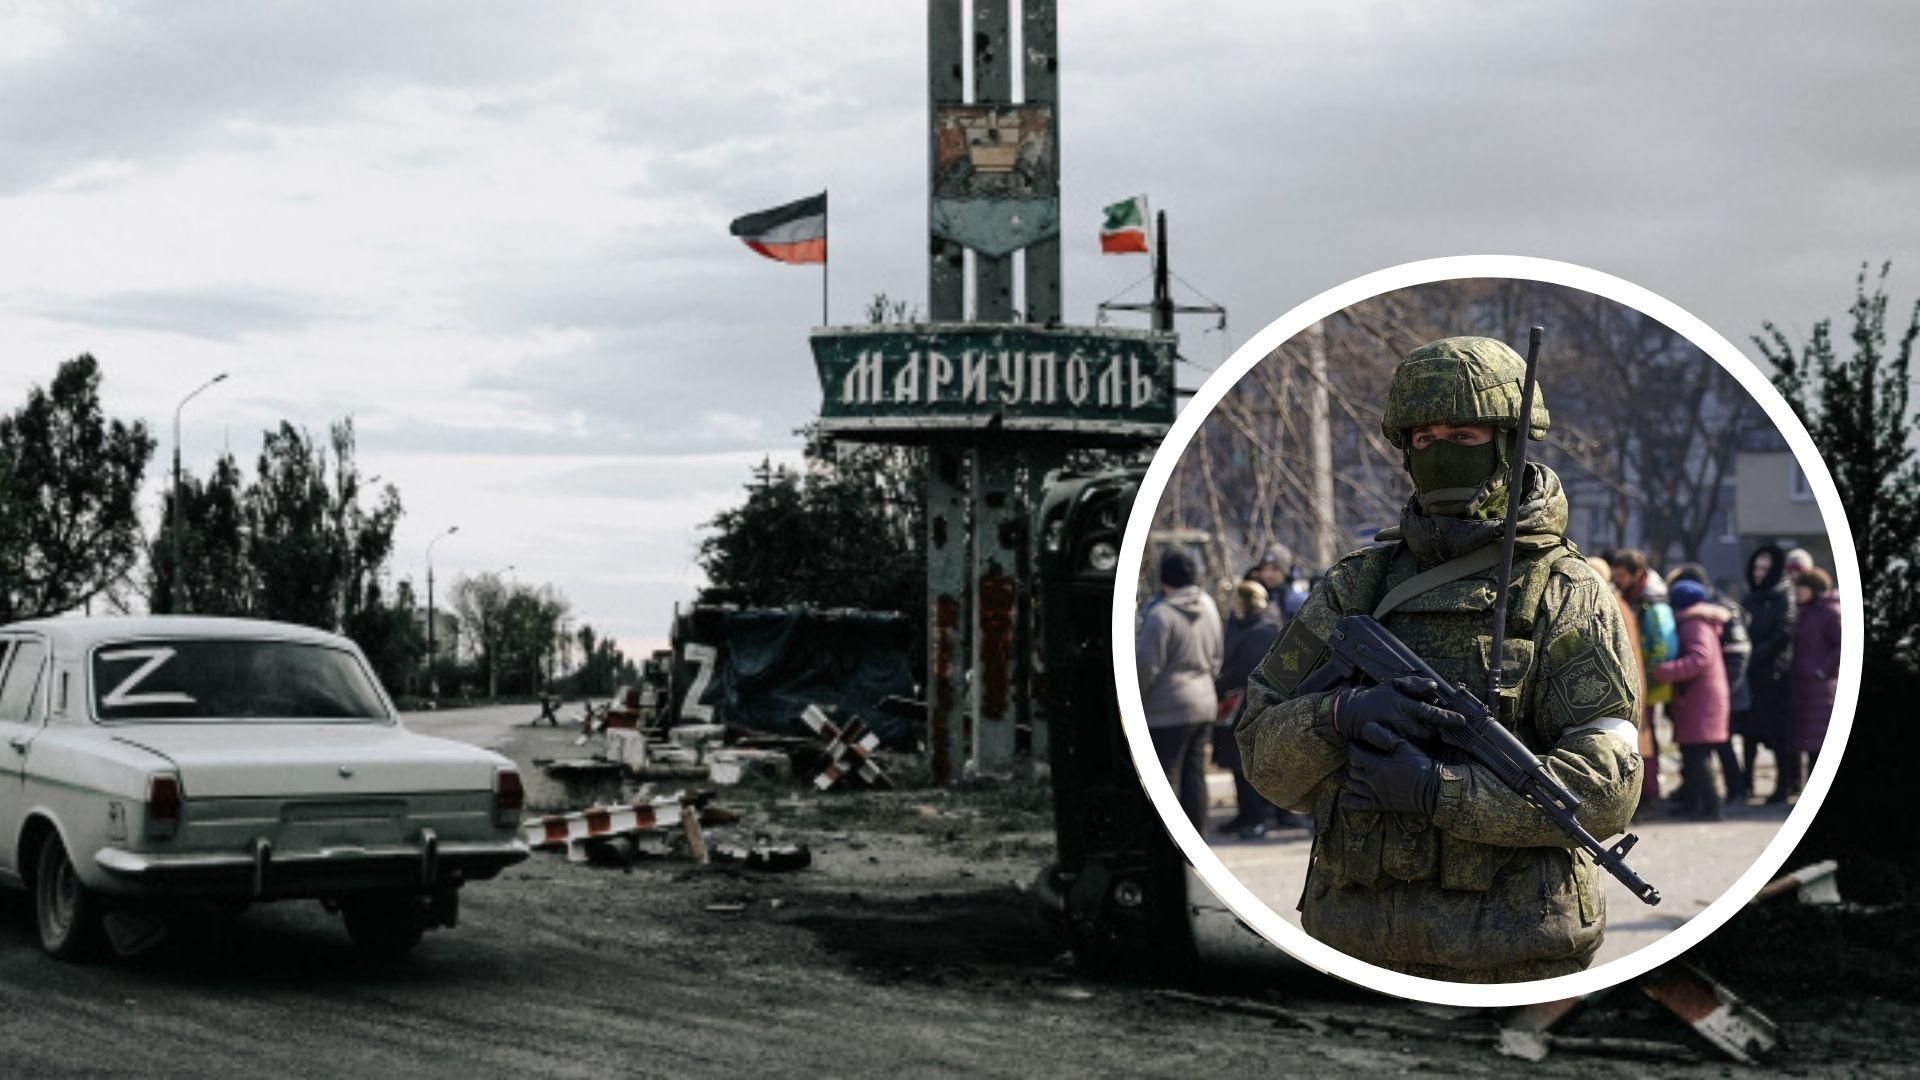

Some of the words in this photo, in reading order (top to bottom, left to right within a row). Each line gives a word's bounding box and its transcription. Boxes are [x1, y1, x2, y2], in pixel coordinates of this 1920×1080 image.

[842, 350, 1153, 409] МАРИУПОЛЬ
[99, 645, 196, 706] Z
[681, 642, 717, 723] Z
[1563, 662, 1595, 683] РОССИЯ
